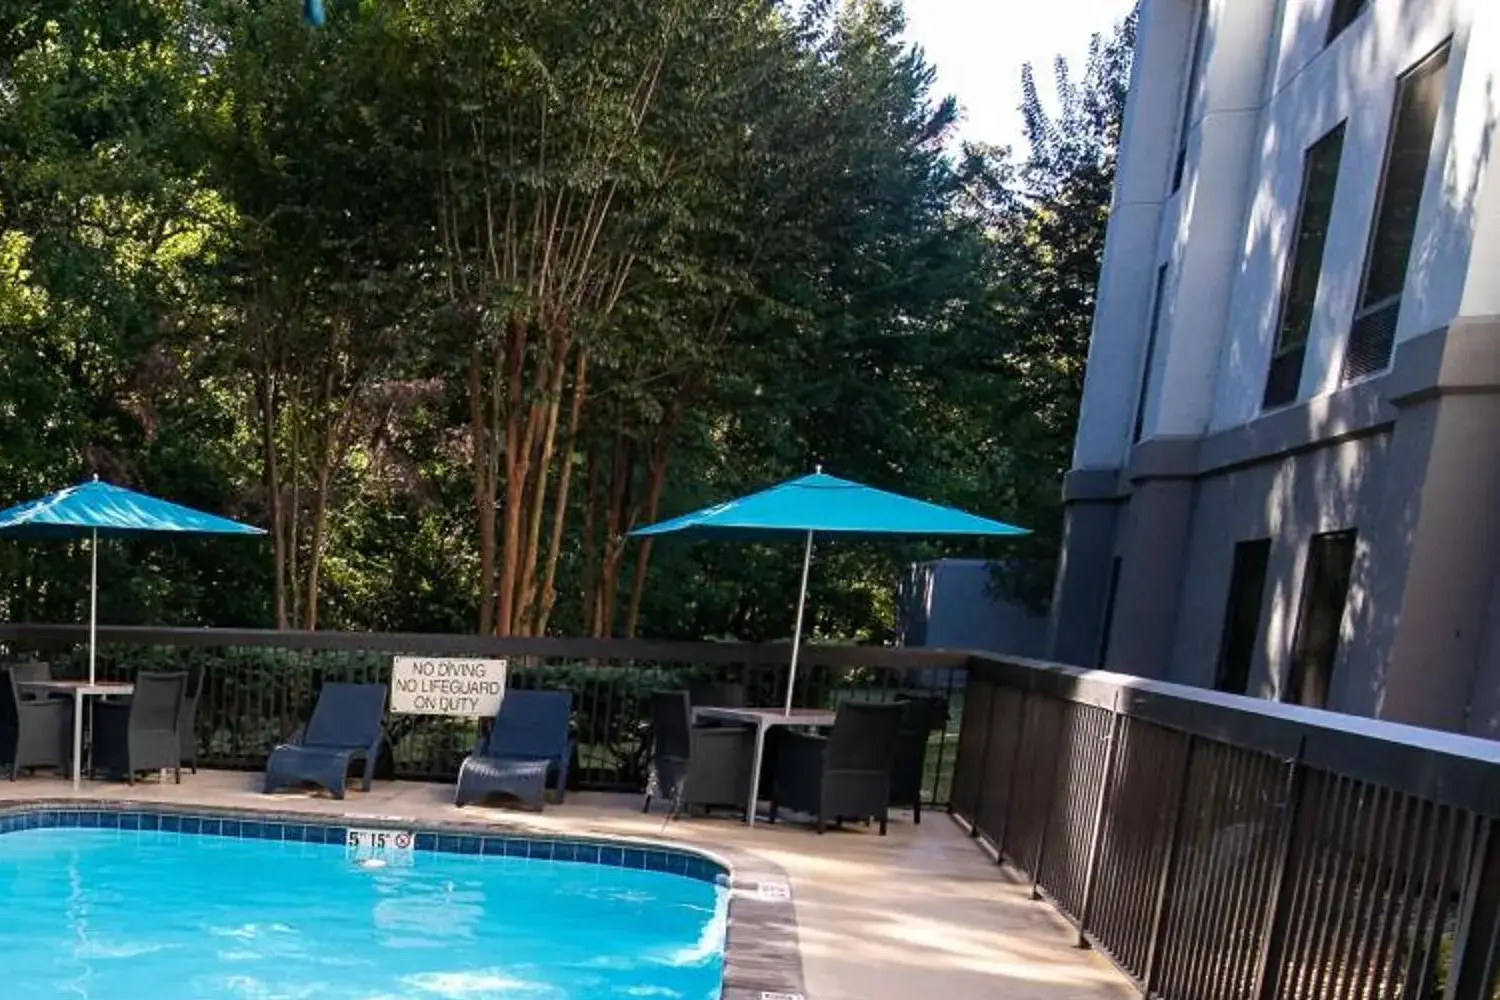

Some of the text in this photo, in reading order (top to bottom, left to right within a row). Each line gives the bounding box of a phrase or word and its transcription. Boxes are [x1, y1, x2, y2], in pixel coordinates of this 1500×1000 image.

[412, 661, 486, 678] NO DIVING
[396, 678, 500, 695] NO LIFEGUARD
[413, 695, 480, 711] ON DUTY
